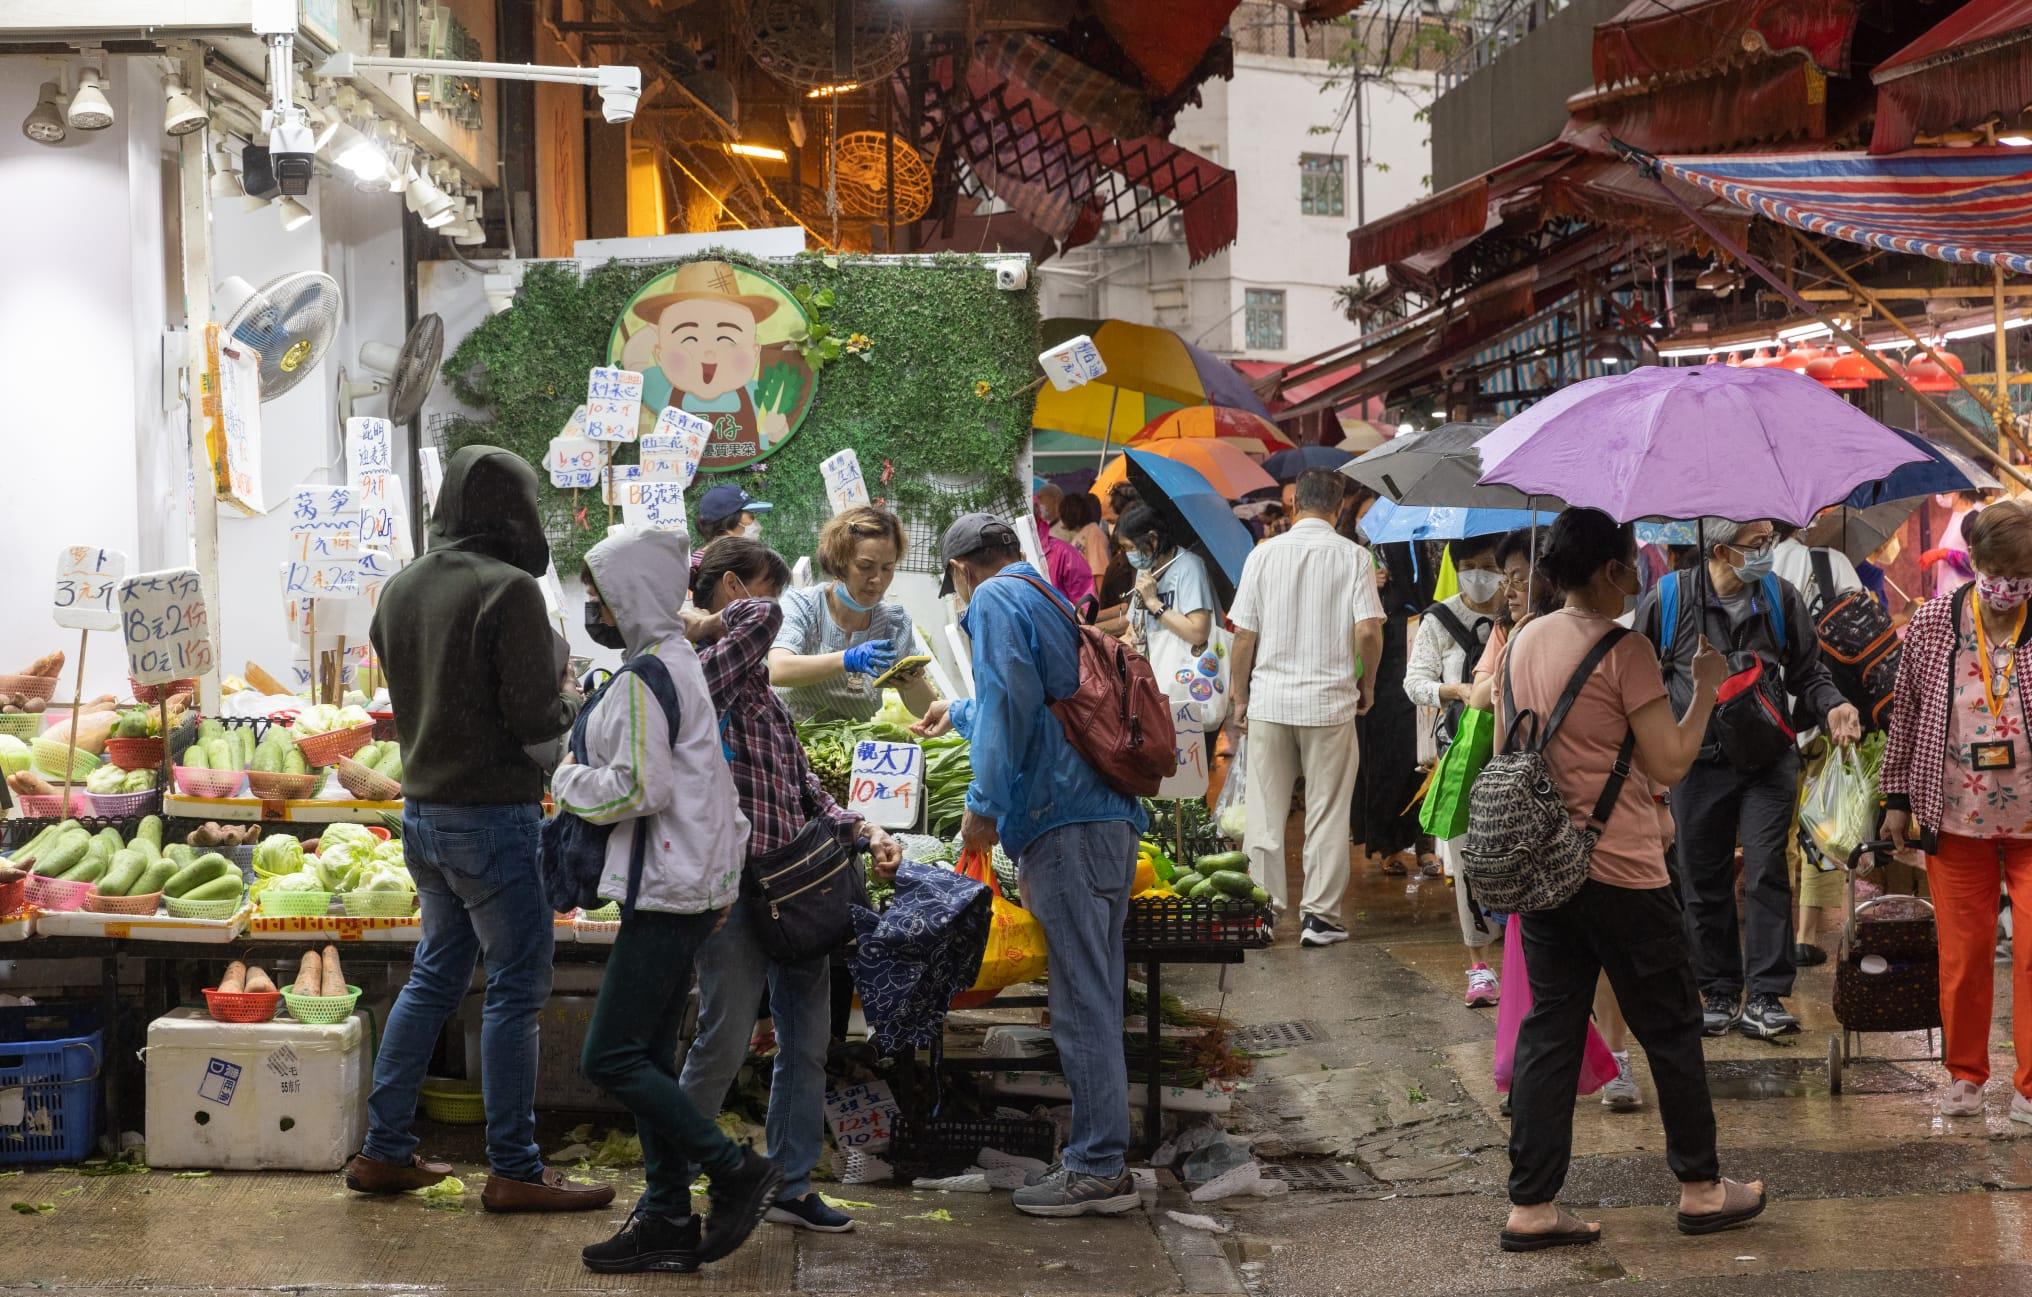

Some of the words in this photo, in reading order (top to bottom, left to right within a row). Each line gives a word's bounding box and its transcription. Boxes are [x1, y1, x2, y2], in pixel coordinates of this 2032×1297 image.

[362, 418, 385, 445] 昆明
[54, 580, 115, 613] 3元斤
[123, 602, 208, 646] 18元2份
[850, 777, 912, 809] 10元斤
